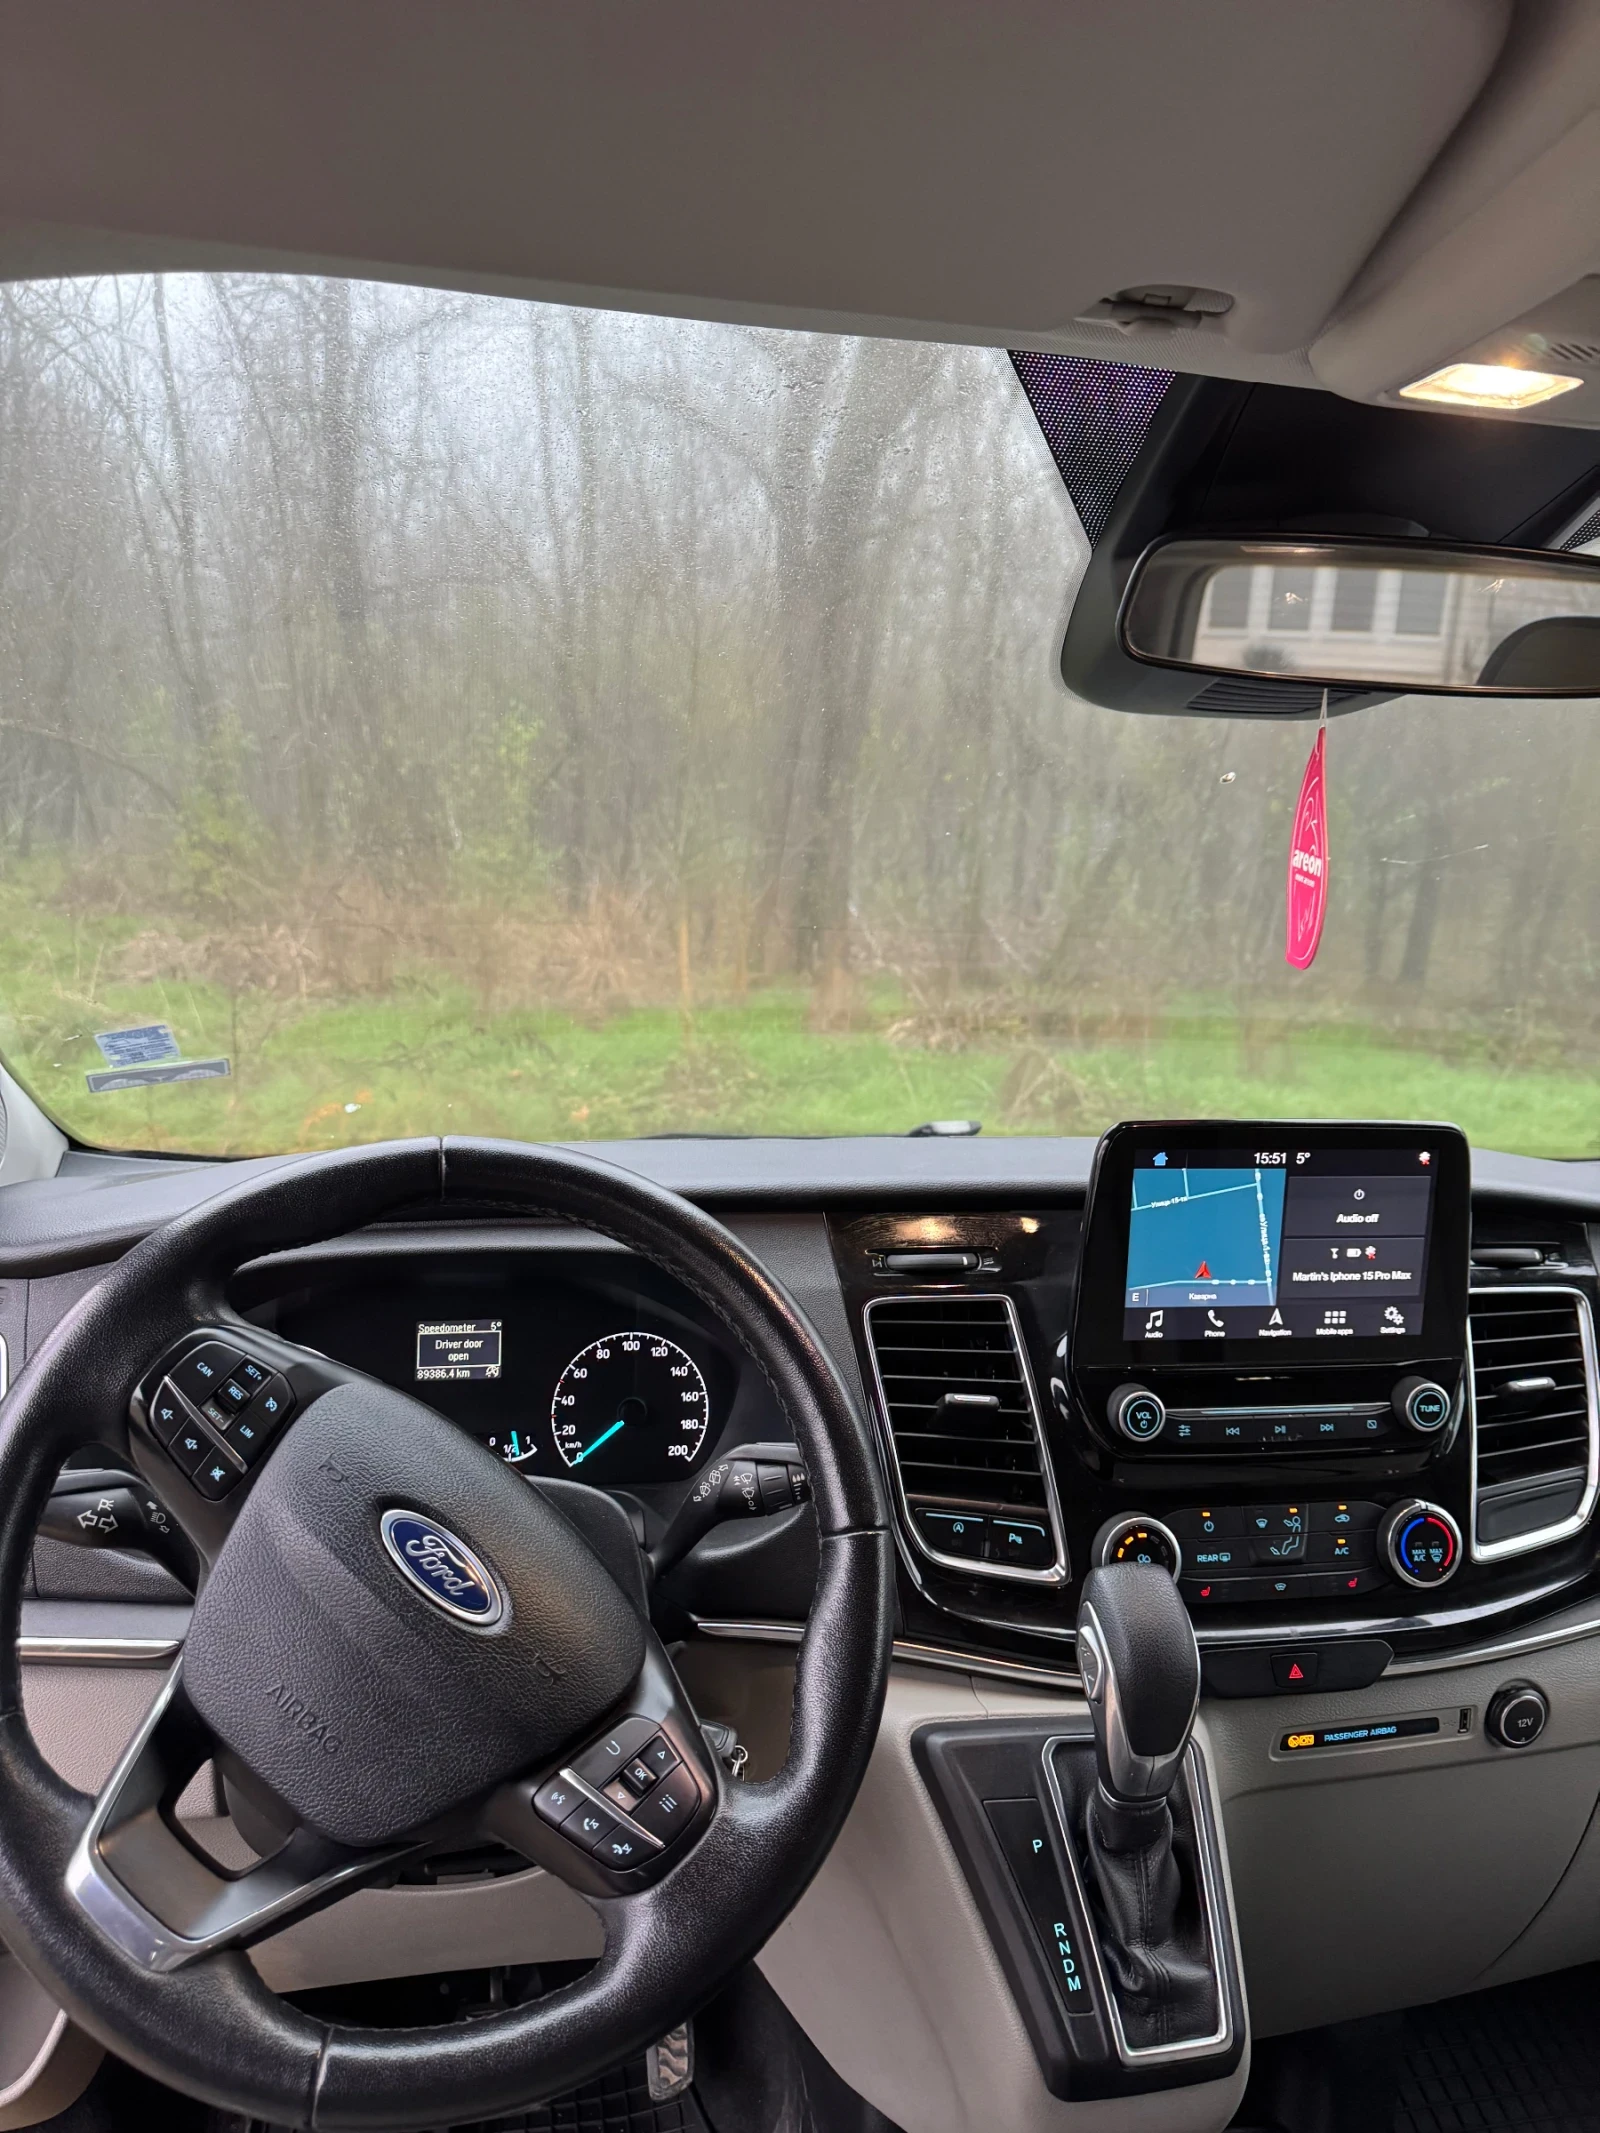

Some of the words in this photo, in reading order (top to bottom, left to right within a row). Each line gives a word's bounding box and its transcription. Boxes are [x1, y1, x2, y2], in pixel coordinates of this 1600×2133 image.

[1292, 849, 1322, 877] areon
[1254, 1152, 1287, 1165] 15:51
[1296, 1152, 1311, 1165] 5°
[1336, 1214, 1364, 1223] Audio
[1365, 1213, 1379, 1223] off
[1293, 1272, 1329, 1281] Martin's
[1330, 1272, 1361, 1283] Iphone
[1362, 1271, 1374, 1280] 15
[1375, 1271, 1391, 1280] Pro
[1392, 1271, 1412, 1280] Max
[1132, 1293, 1139, 1301] E
[418, 1323, 476, 1333] Speedometer
[1258, 1329, 1292, 1337] Navigation
[1338, 1328, 1353, 1336] apps
[1380, 1326, 1406, 1334] Settings
[1145, 1331, 1164, 1339] Audio
[435, 1340, 462, 1349] Driver
[464, 1339, 483, 1348] door
[622, 1340, 640, 1352] 100
[448, 1352, 469, 1362] open
[596, 1348, 610, 1359] 80
[650, 1346, 668, 1358] 120
[197, 1362, 214, 1377] CAN
[245, 1365, 262, 1381] SET+
[417, 1369, 455, 1379] 89386.4
[456, 1369, 470, 1377] km
[573, 1368, 588, 1379] 60
[670, 1366, 688, 1377] 140
[228, 1386, 243, 1400] RES
[681, 1391, 699, 1403] 160
[561, 1395, 575, 1406] 40
[1419, 1404, 1441, 1413] TUNE
[1135, 1412, 1152, 1420] VOL
[680, 1418, 699, 1430] 180
[239, 1425, 254, 1438] LIM
[562, 1424, 576, 1436] 20
[489, 1437, 496, 1446] 0
[525, 1436, 530, 1444] 1
[668, 1445, 688, 1457] 200
[1334, 1546, 1349, 1556] A/C
[1412, 1548, 1426, 1556] MAX
[1197, 1553, 1218, 1563] REAR
[1413, 1554, 1426, 1563] A/C
[405, 1535, 475, 1596] Ford
[264, 1684, 342, 1754] AIRBAG
[1517, 1717, 1534, 1728] 12V
[1324, 1730, 1368, 1742] PASSENGER
[1370, 1726, 1397, 1736] AIRBAG
[635, 1768, 647, 1780] OK
[1032, 1839, 1043, 1853] P
[1053, 1922, 1066, 1937] R
[1058, 1941, 1071, 1955] N
[1063, 1958, 1075, 1973] D
[1067, 1975, 1081, 1992] M
